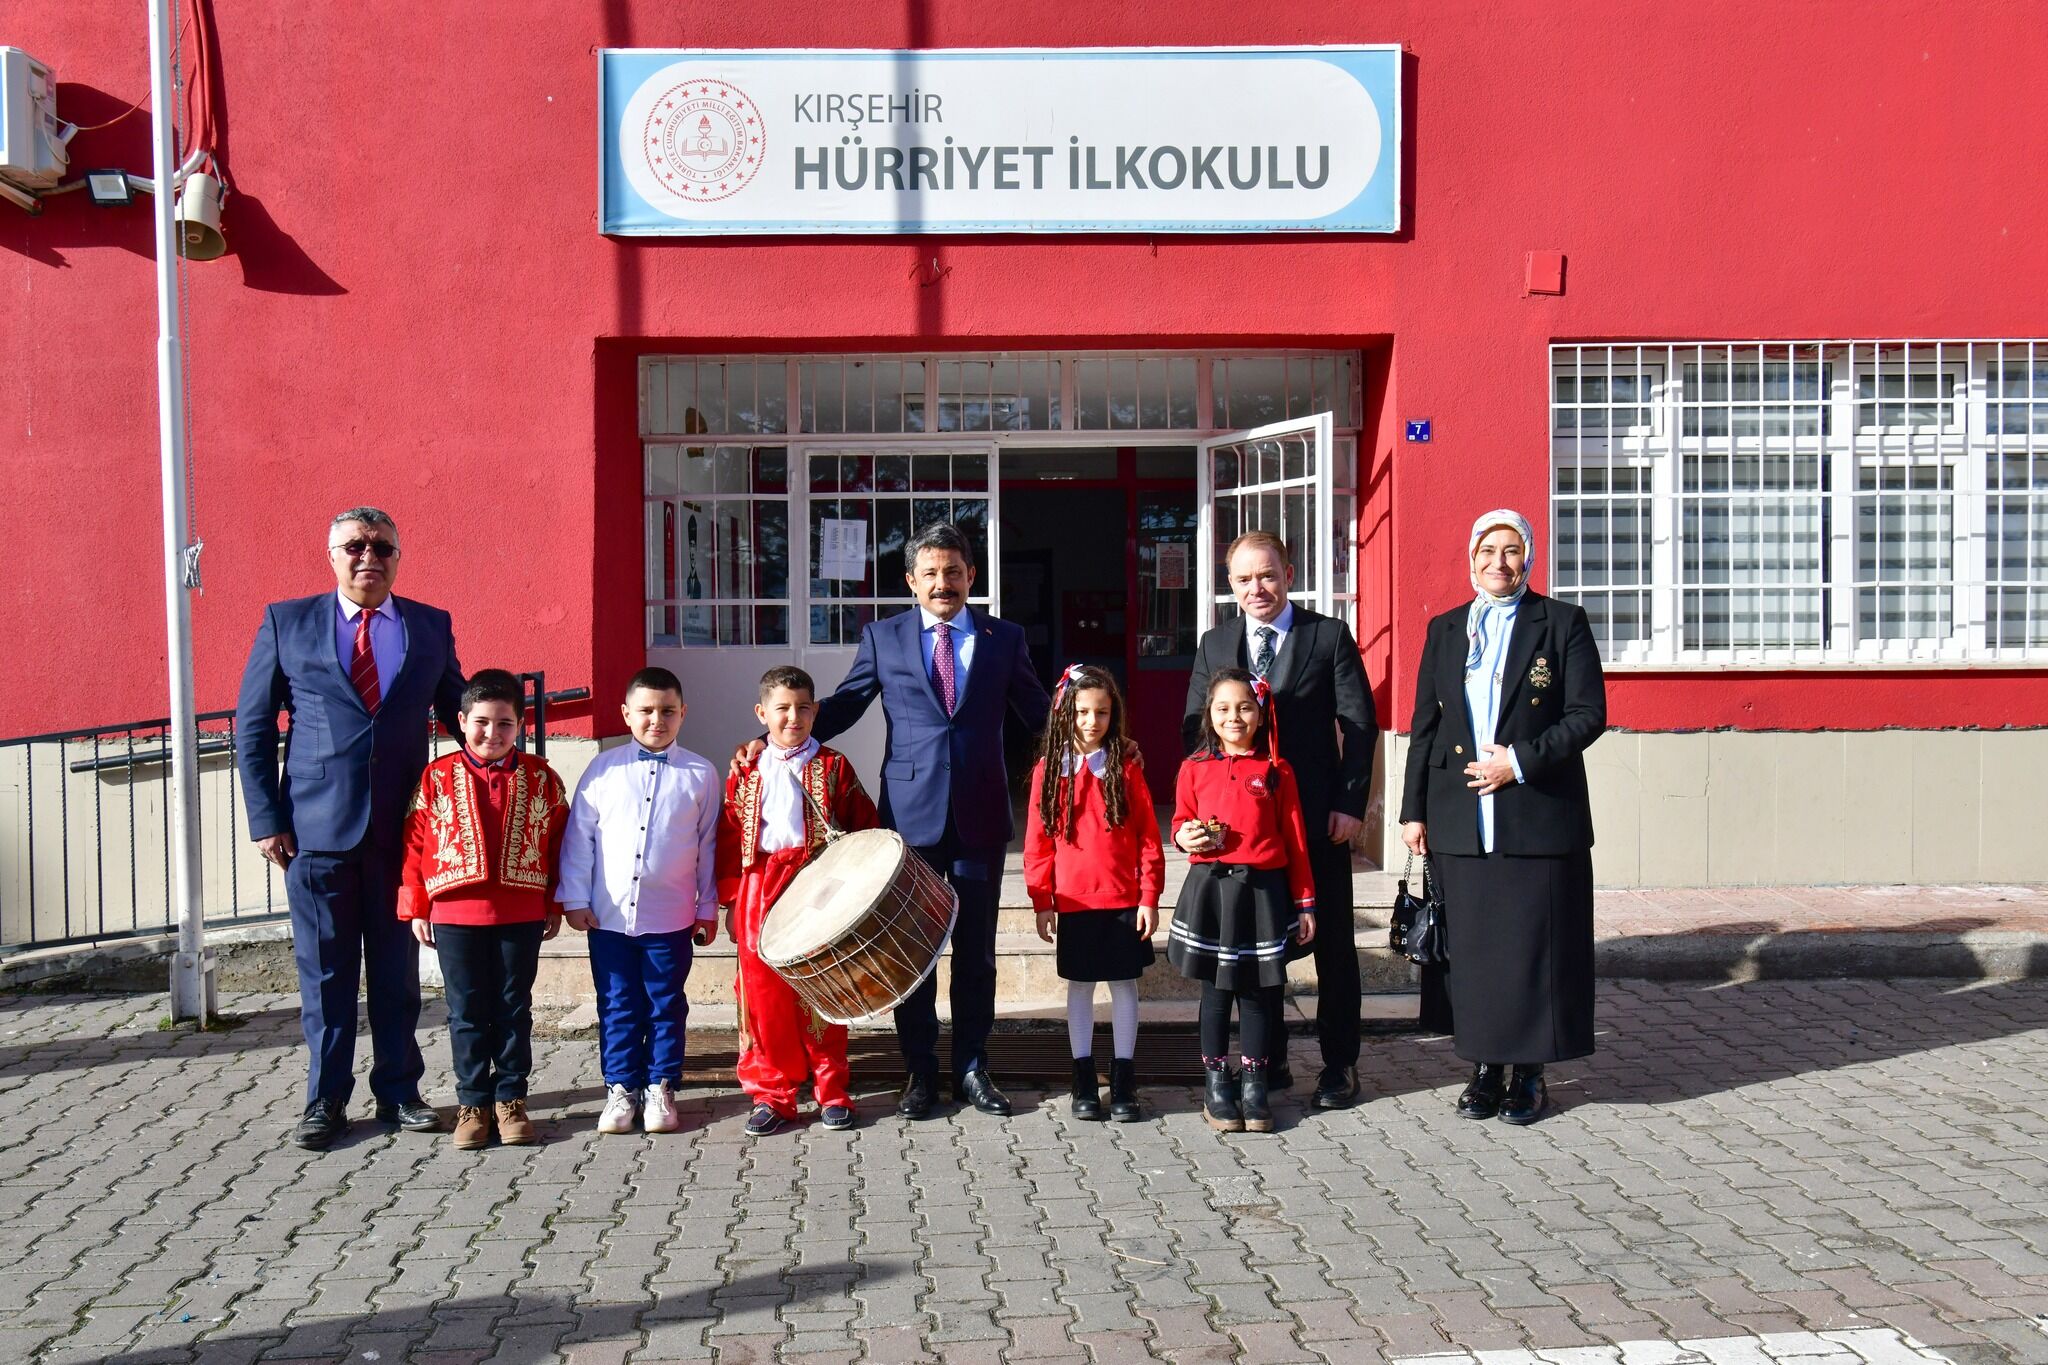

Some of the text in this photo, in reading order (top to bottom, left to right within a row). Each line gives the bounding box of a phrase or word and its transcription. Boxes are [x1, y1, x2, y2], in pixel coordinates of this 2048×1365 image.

[795, 89, 942, 131] KIRŞEHİR
[666, 101, 744, 178] TÜRKİYE CUMHURİYETİ MİLLİ EĞİTİM BAKANLIĞI
[795, 136, 1329, 190] HÜRRİYET İLKOKULU
[1415, 424, 1422, 435] 7
